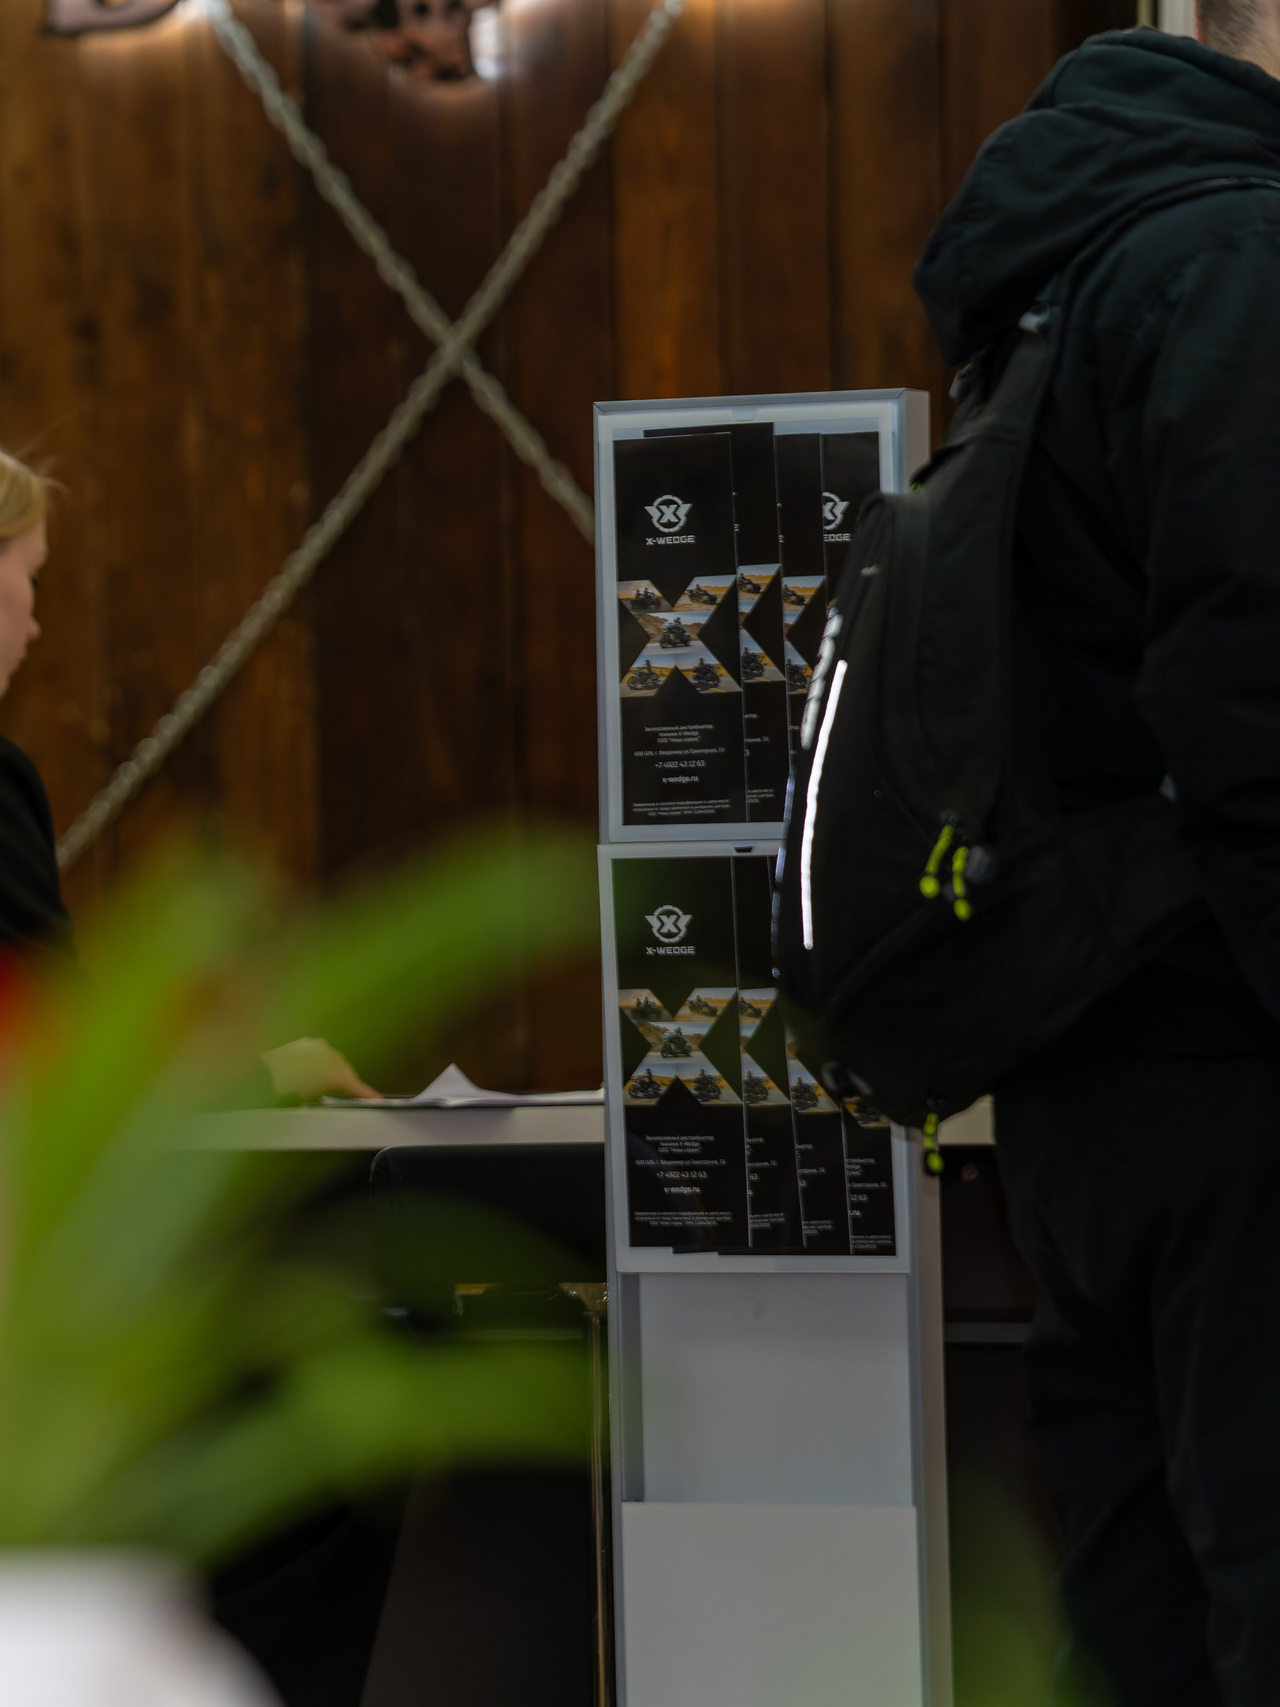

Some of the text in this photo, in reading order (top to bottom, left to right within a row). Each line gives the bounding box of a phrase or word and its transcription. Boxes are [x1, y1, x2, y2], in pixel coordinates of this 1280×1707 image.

[645, 535, 696, 546] X-WEDGE
[823, 533, 852, 543] EDGE
[661, 775, 699, 783] x-wedge.ru
[645, 945, 696, 955] X-WEDGE
